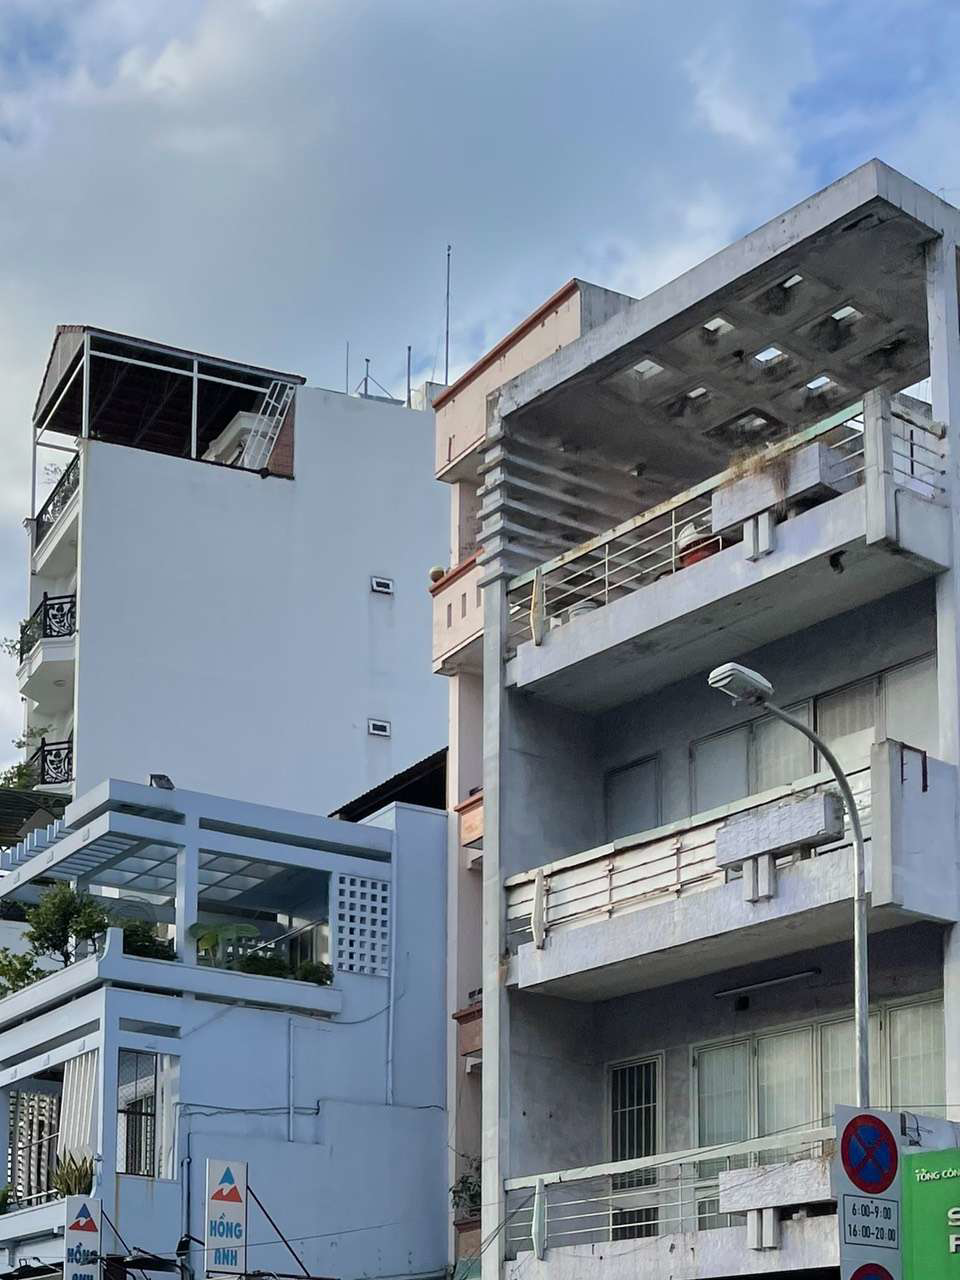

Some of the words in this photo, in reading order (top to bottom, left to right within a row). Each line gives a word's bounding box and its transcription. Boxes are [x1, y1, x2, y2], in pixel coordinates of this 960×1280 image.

[915, 1168, 940, 1182] TỔNG
[209, 1213, 242, 1239] HỒNG
[214, 1248, 238, 1266] ANH
